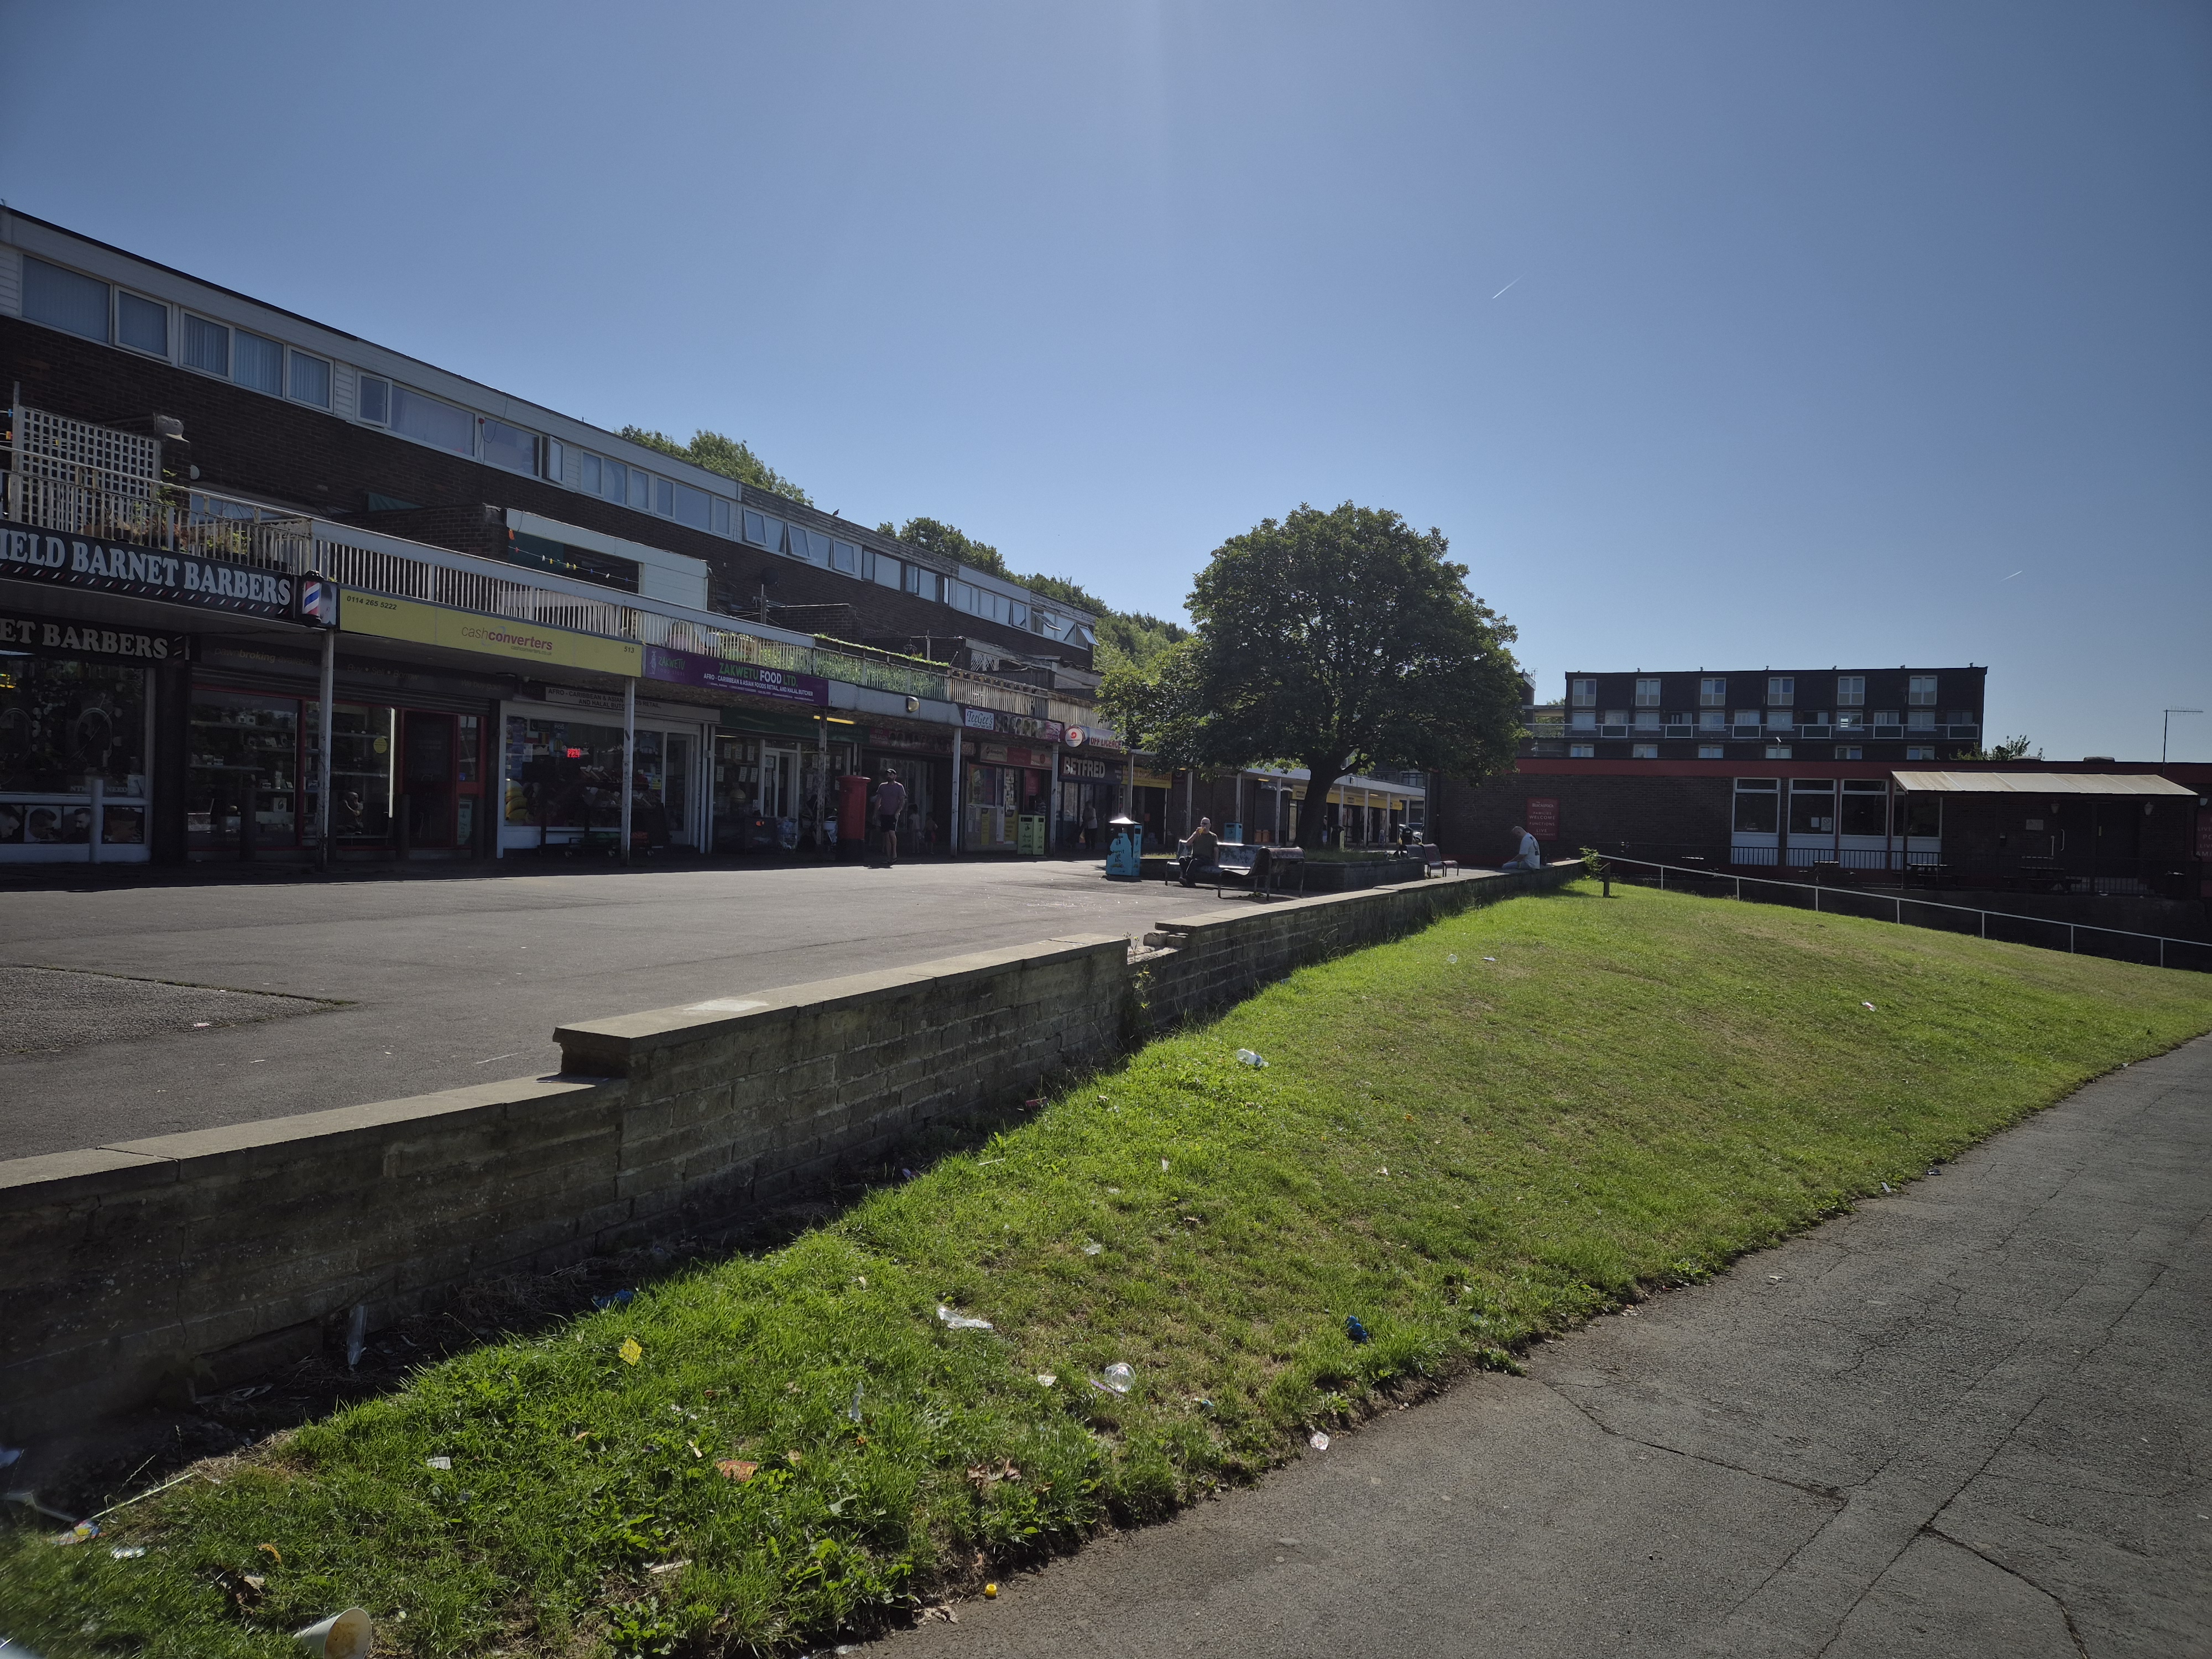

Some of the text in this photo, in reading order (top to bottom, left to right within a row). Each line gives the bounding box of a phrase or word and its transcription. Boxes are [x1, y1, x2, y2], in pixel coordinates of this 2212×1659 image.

[71, 541, 179, 587] BARNET
[184, 561, 291, 606] BARBERS
[347, 596, 363, 604] 0114
[42, 623, 168, 659] BARBERS
[461, 627, 553, 651] cashconverters
[215, 648, 314, 666] pawnbroking available
[658, 656, 686, 670] ZAKWETU
[347, 664, 362, 675] Buy
[371, 667, 384, 675] Sell
[719, 662, 798, 687] ZAKWETU FOOD LTD.
[717, 675, 739, 685] CARIBBEAN
[569, 691, 602, 700] CARIBBEAN
[967, 710, 993, 728] TeeGee's
[1091, 737, 1100, 745] OFF
[1100, 739, 1121, 750] LICENCE
[1063, 757, 1105, 779] BETFRED
